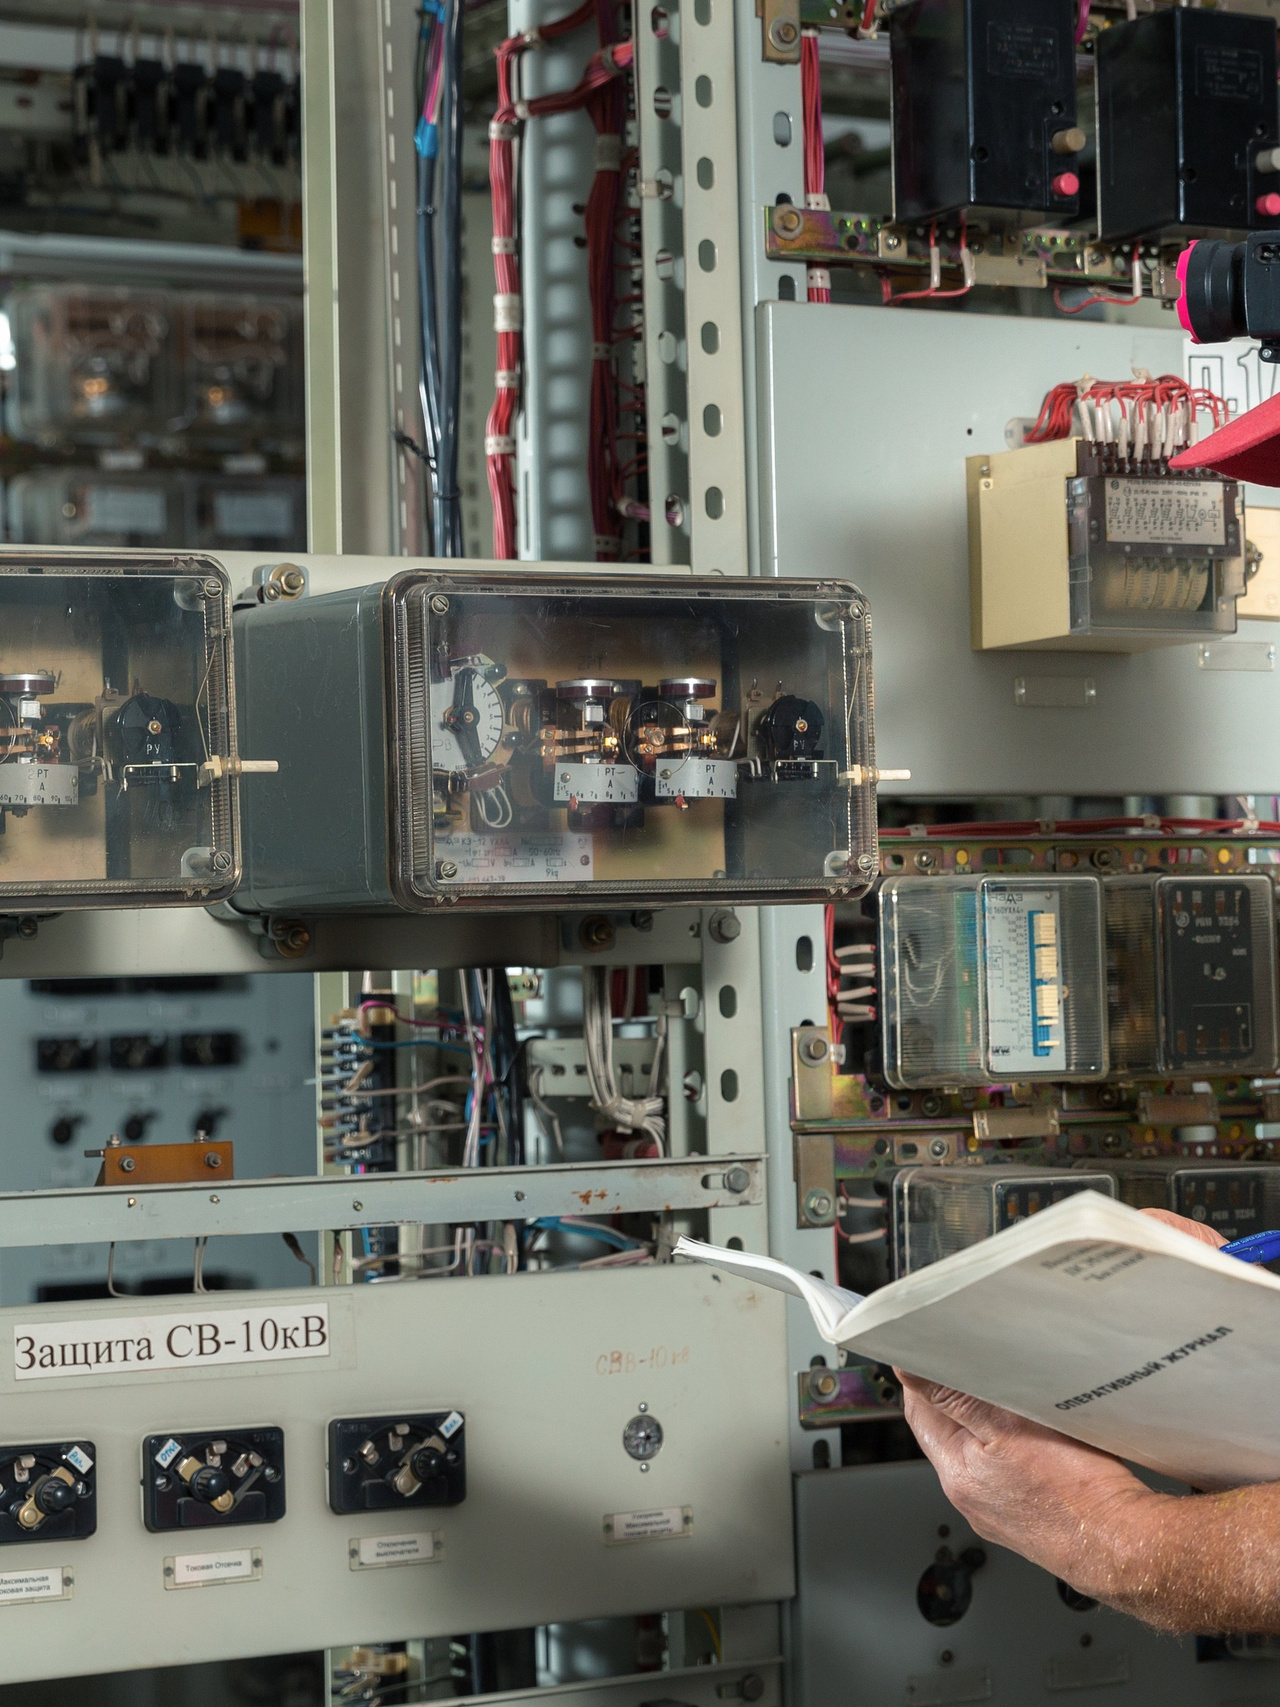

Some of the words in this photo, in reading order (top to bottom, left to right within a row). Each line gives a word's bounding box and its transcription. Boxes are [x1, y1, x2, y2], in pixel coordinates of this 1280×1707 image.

[15, 1335, 155, 1371] Защита
[166, 1314, 328, 1358] СВ-10кВ
[1055, 1361, 1166, 1410] ОПЕРАТИВНЫЙ
[1161, 1325, 1233, 1364] ЖУРНАЛ
